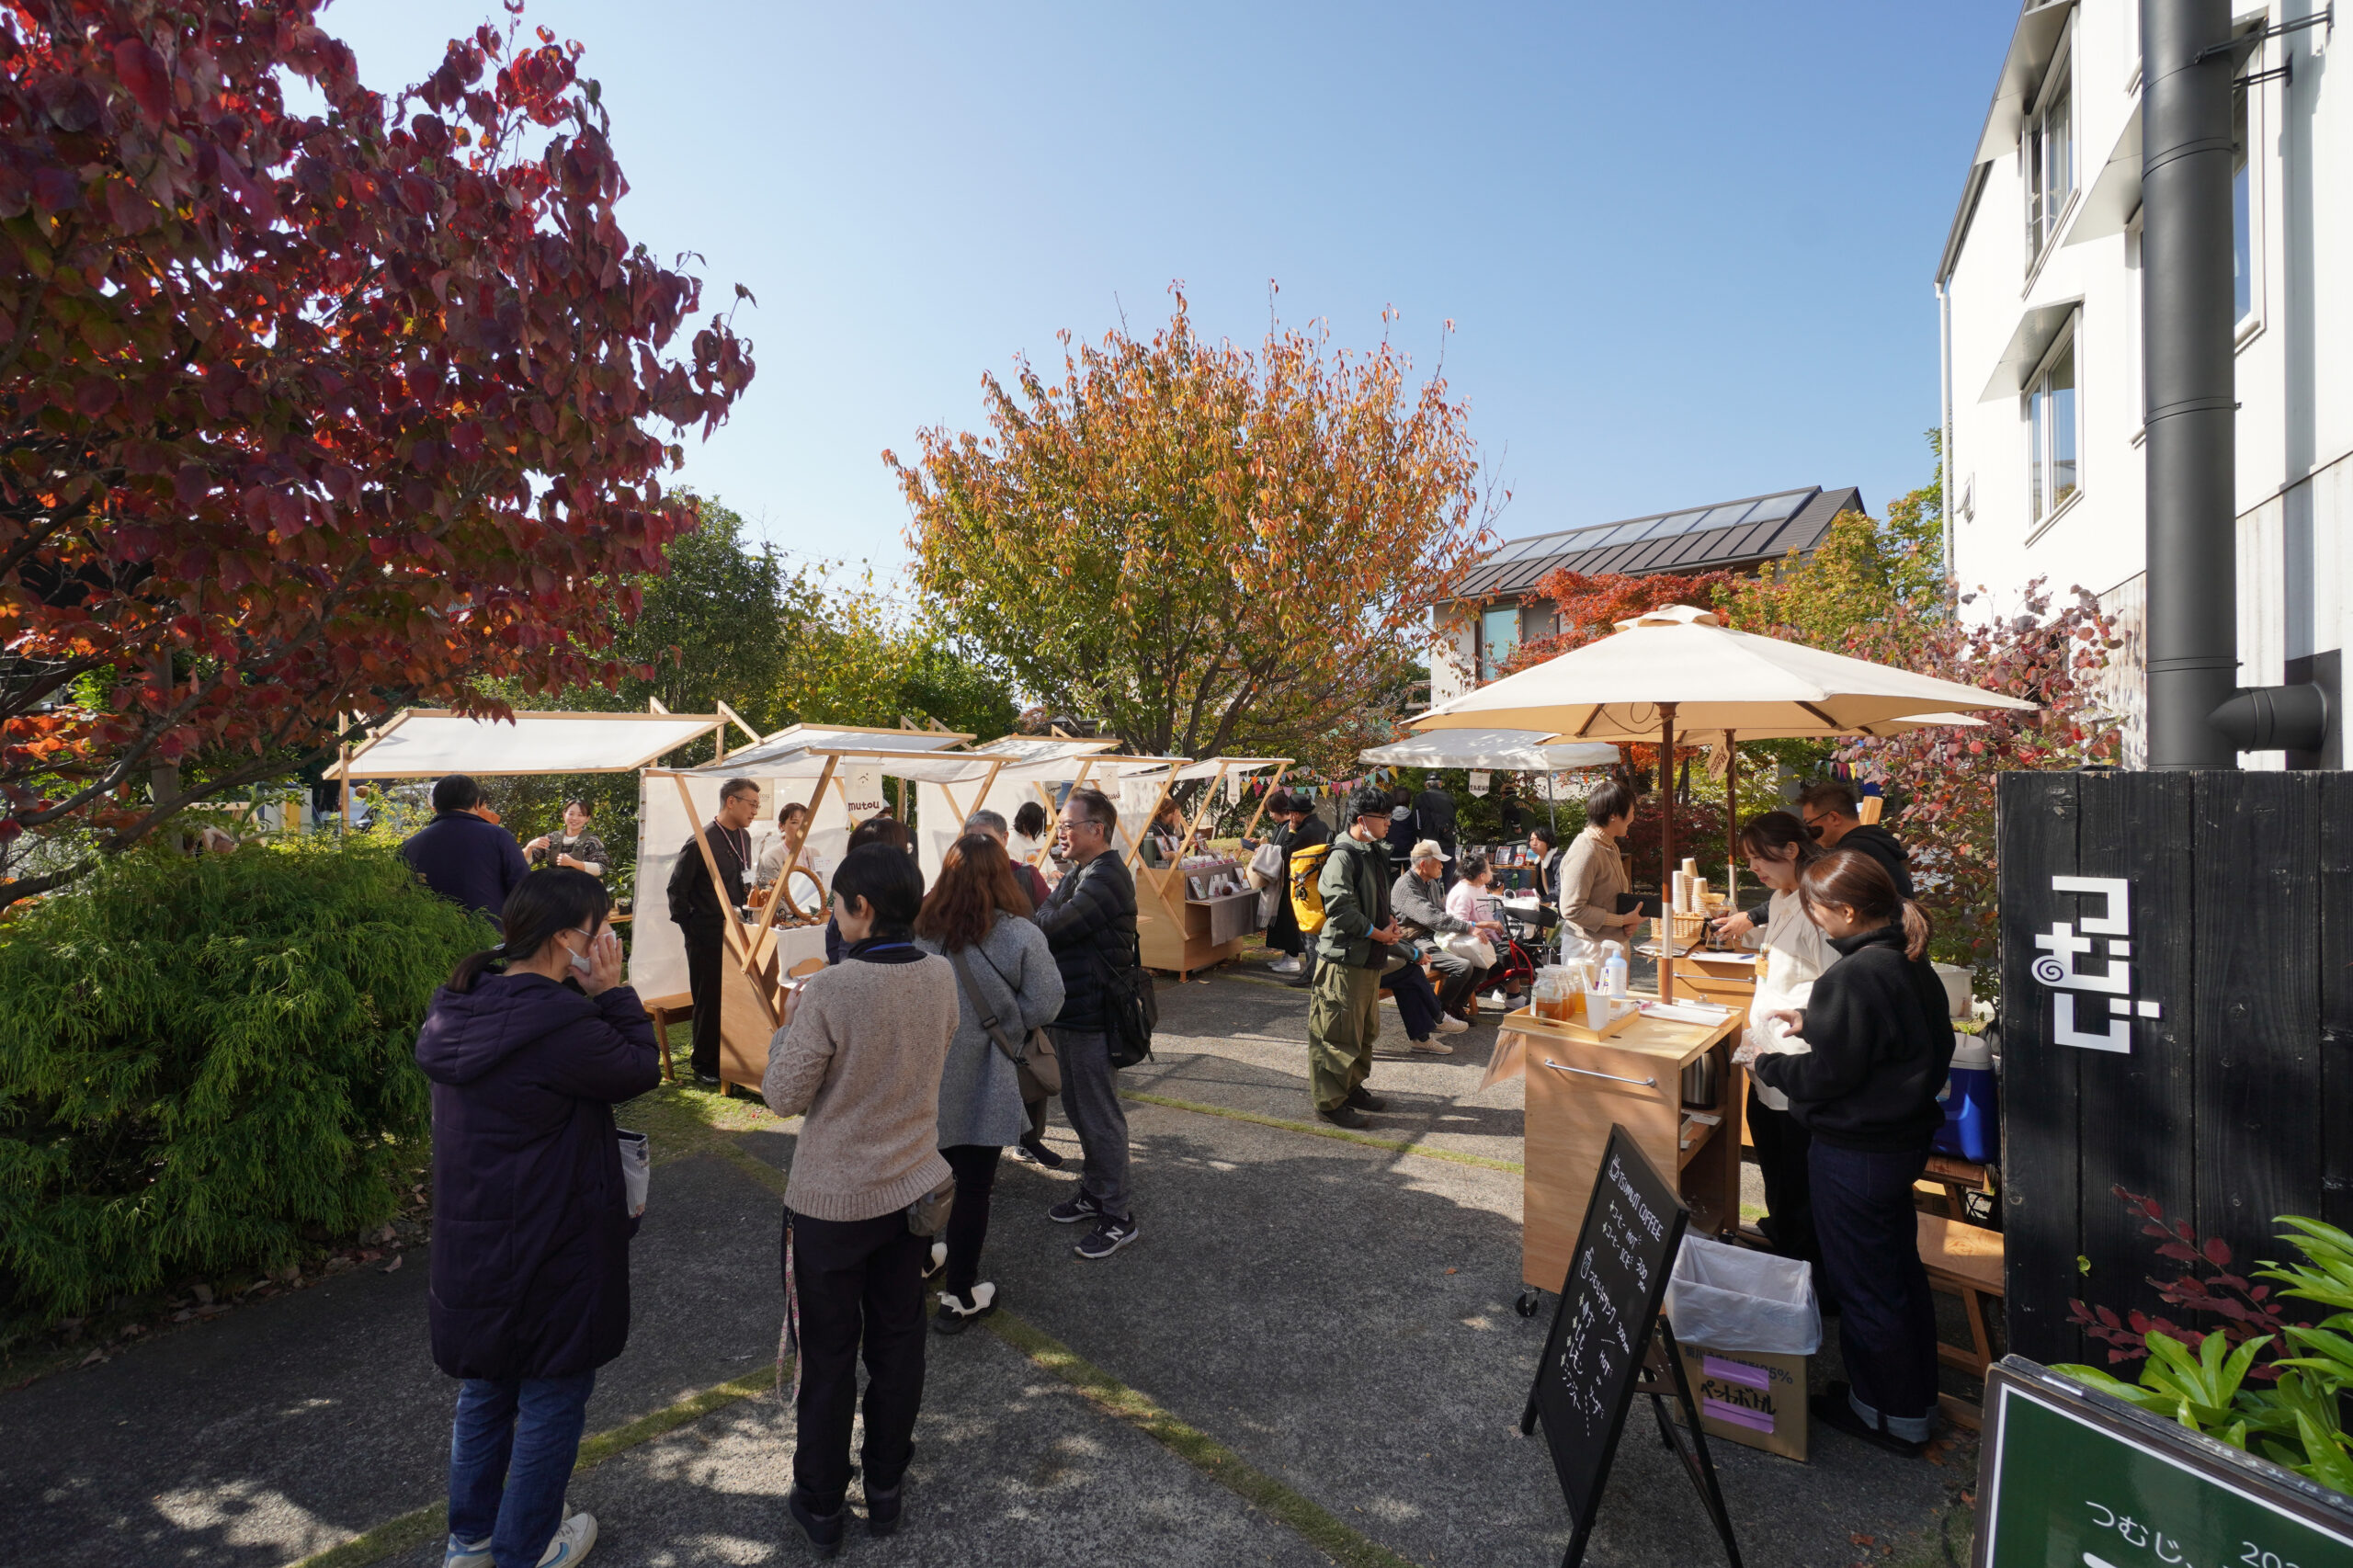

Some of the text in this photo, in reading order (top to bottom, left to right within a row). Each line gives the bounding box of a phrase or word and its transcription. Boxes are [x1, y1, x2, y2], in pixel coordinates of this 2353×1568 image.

[847, 801, 880, 812] mutou
[2031, 875, 2161, 1054] つむじ
[1612, 1206, 1638, 1250] コーヒー HOT
[1638, 1202, 1664, 1242] COFFEE
[1619, 1247, 1631, 1270] ICE
[1636, 1256, 1648, 1279] 300
[1569, 1343, 1584, 1375] レモン
[1599, 1349, 1610, 1376] HOT
[1700, 1380, 1777, 1415] ペットボトル
[2240, 1541, 2300, 1568] 20
